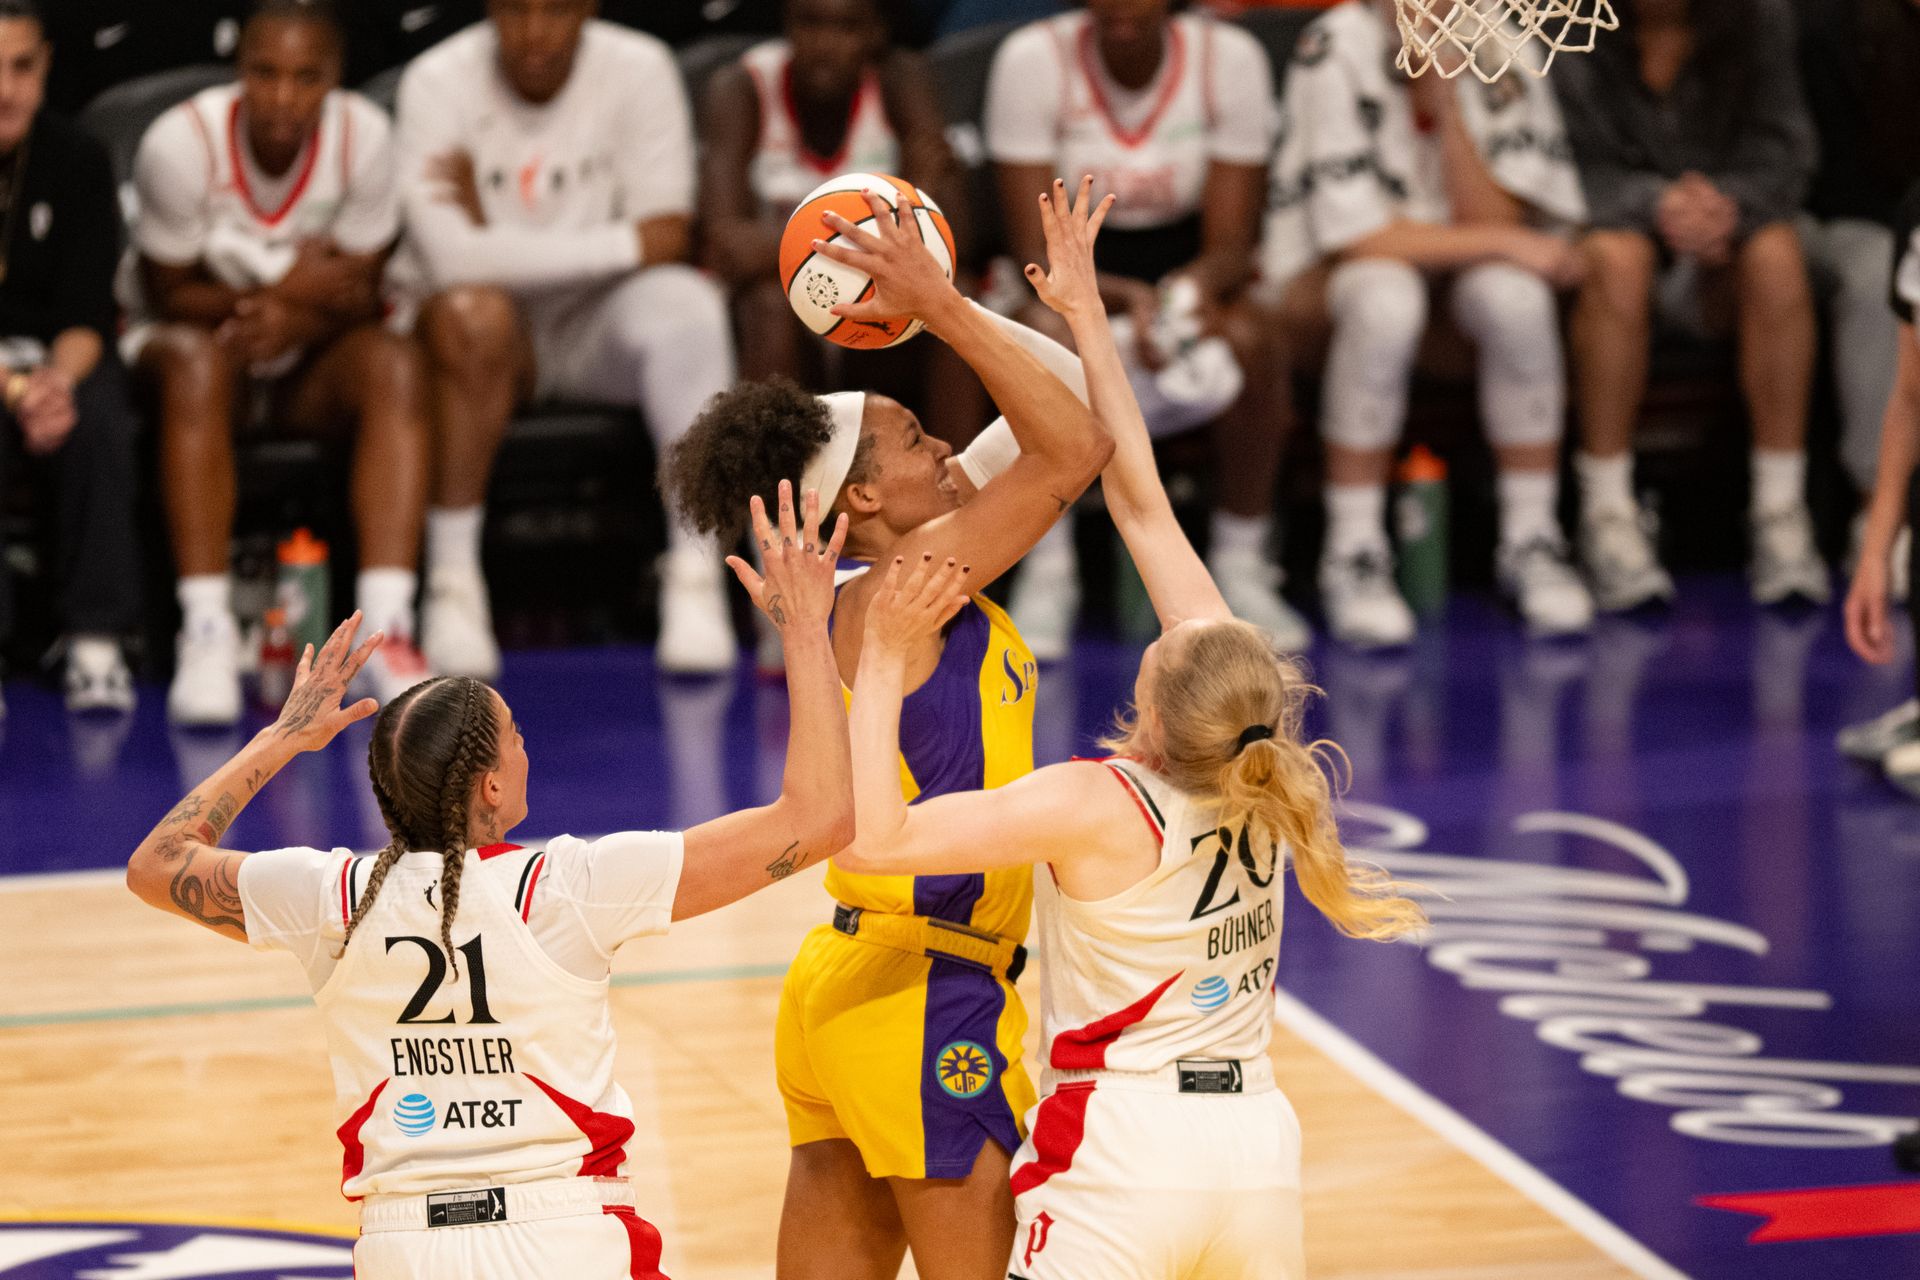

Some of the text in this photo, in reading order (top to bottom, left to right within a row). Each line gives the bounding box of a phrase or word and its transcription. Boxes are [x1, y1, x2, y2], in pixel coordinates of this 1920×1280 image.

[1189, 808, 1278, 921] 20
[1207, 898, 1275, 960] BÜHNER
[385, 933, 501, 1024] 21
[390, 1037, 516, 1076] ENGSTLER
[443, 1099, 523, 1129] AT&T
